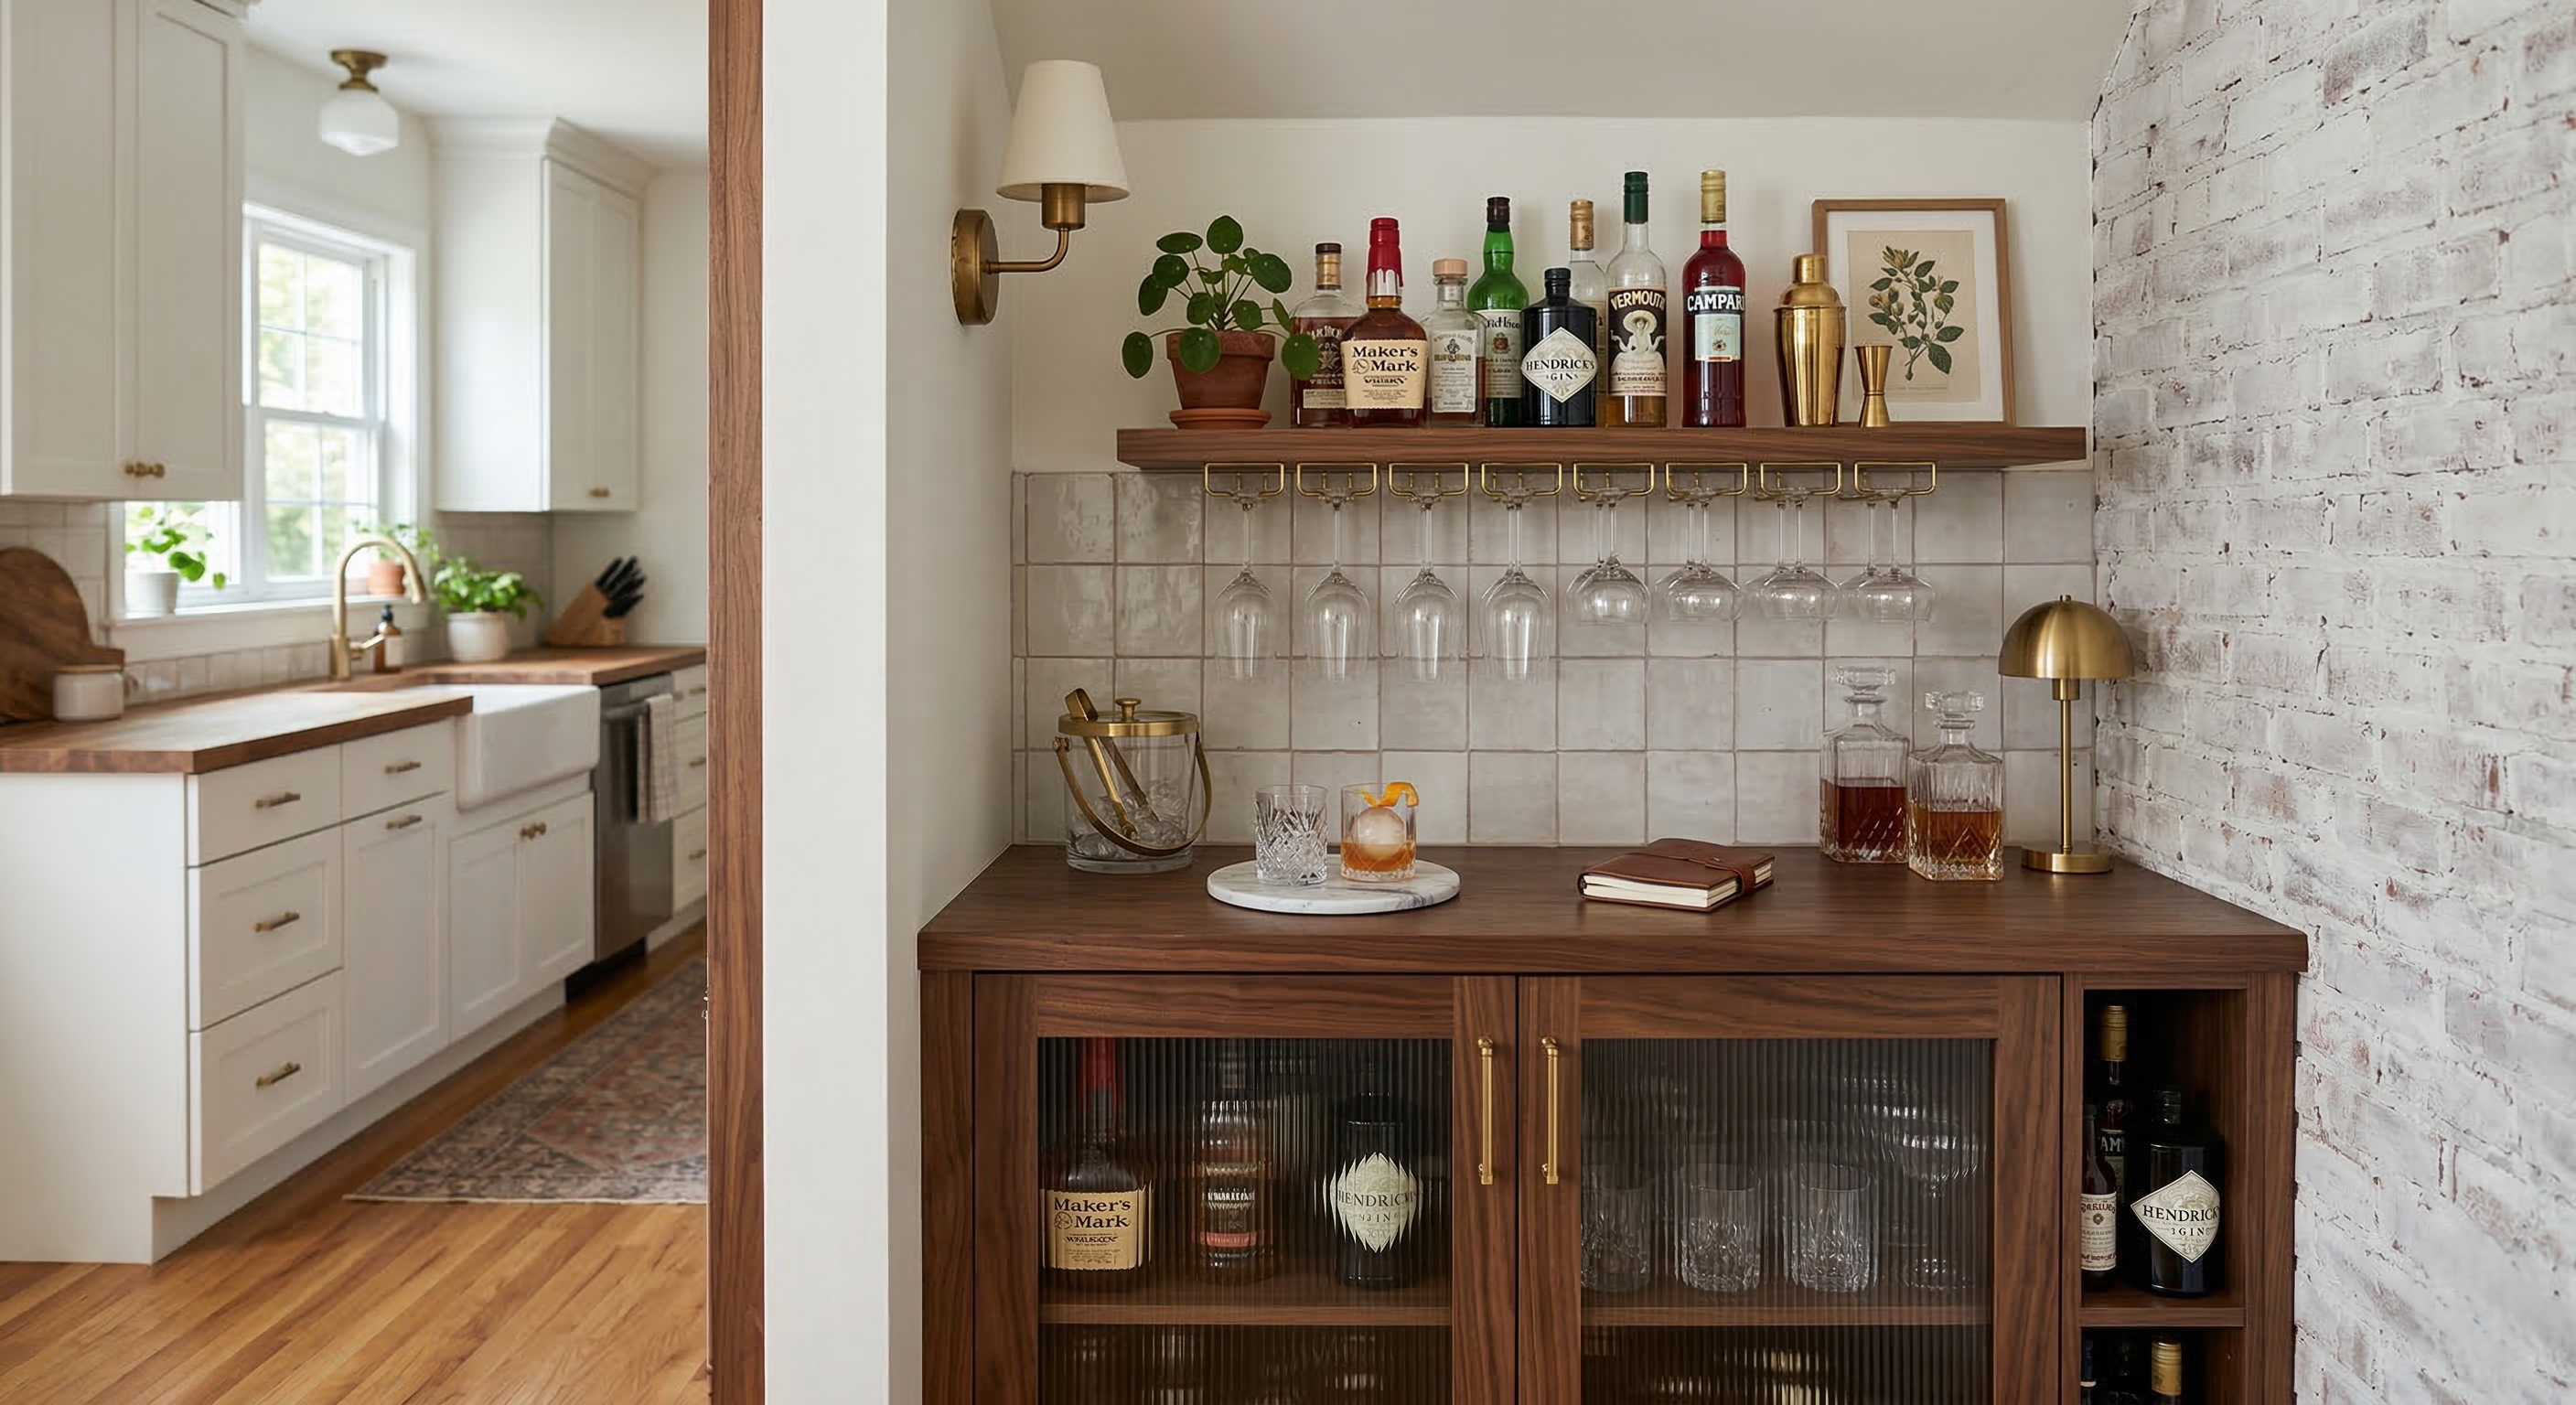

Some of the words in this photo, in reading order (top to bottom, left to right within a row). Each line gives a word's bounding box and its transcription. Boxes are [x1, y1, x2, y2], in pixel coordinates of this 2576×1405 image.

[1687, 294, 1744, 312] CAMPARI
[1352, 346, 1418, 358] Maker's
[1370, 359, 1418, 372] Mark
[1551, 372, 1573, 381] GIN
[1054, 1196, 1131, 1212] Maker's
[1074, 1215, 1131, 1228] Mark
[2178, 1227, 2205, 1236] GIN
